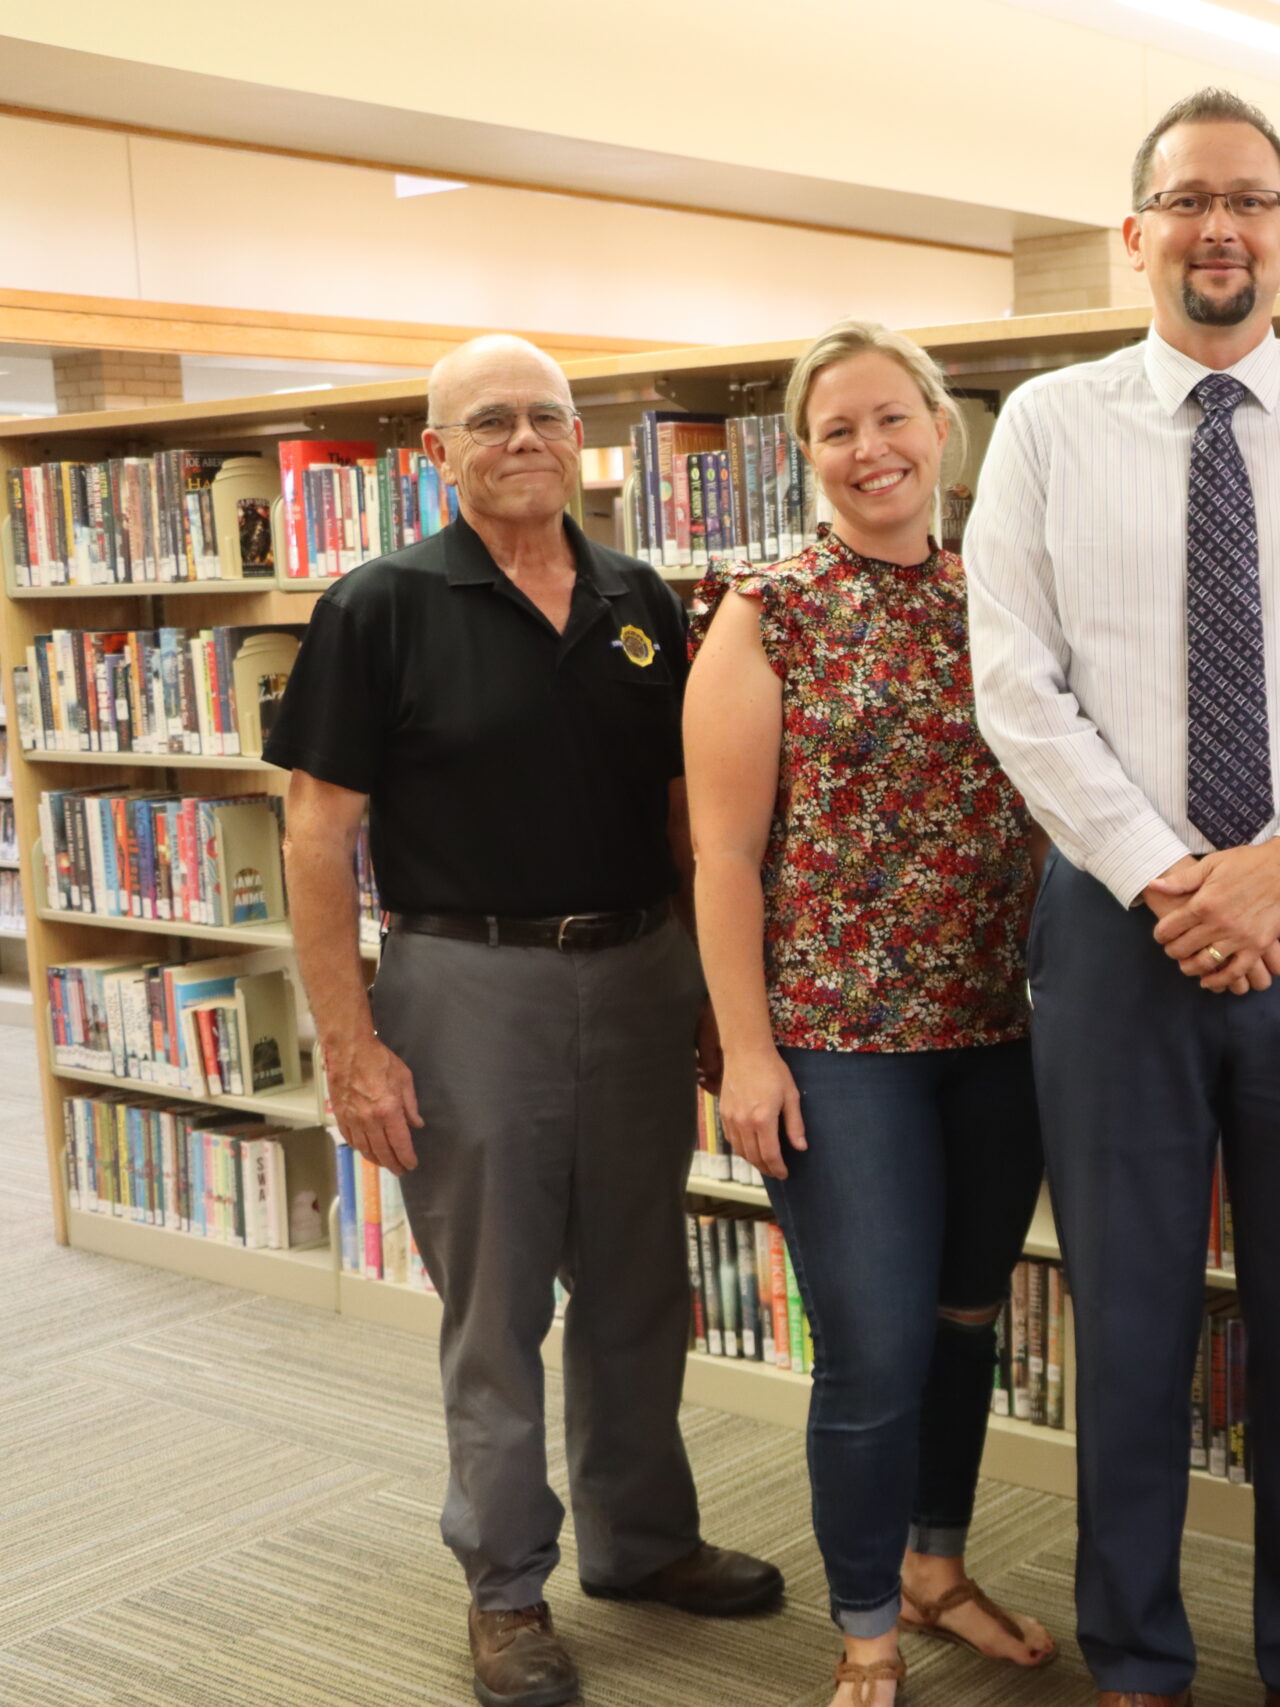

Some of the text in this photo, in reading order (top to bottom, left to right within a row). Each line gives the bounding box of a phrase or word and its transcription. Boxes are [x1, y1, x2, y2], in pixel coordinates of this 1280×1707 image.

[732, 442, 740, 485] ANDREWS
[688, 1217, 698, 1237] ACE
[702, 1225, 710, 1242] THE
[702, 1244, 712, 1269] LOST
